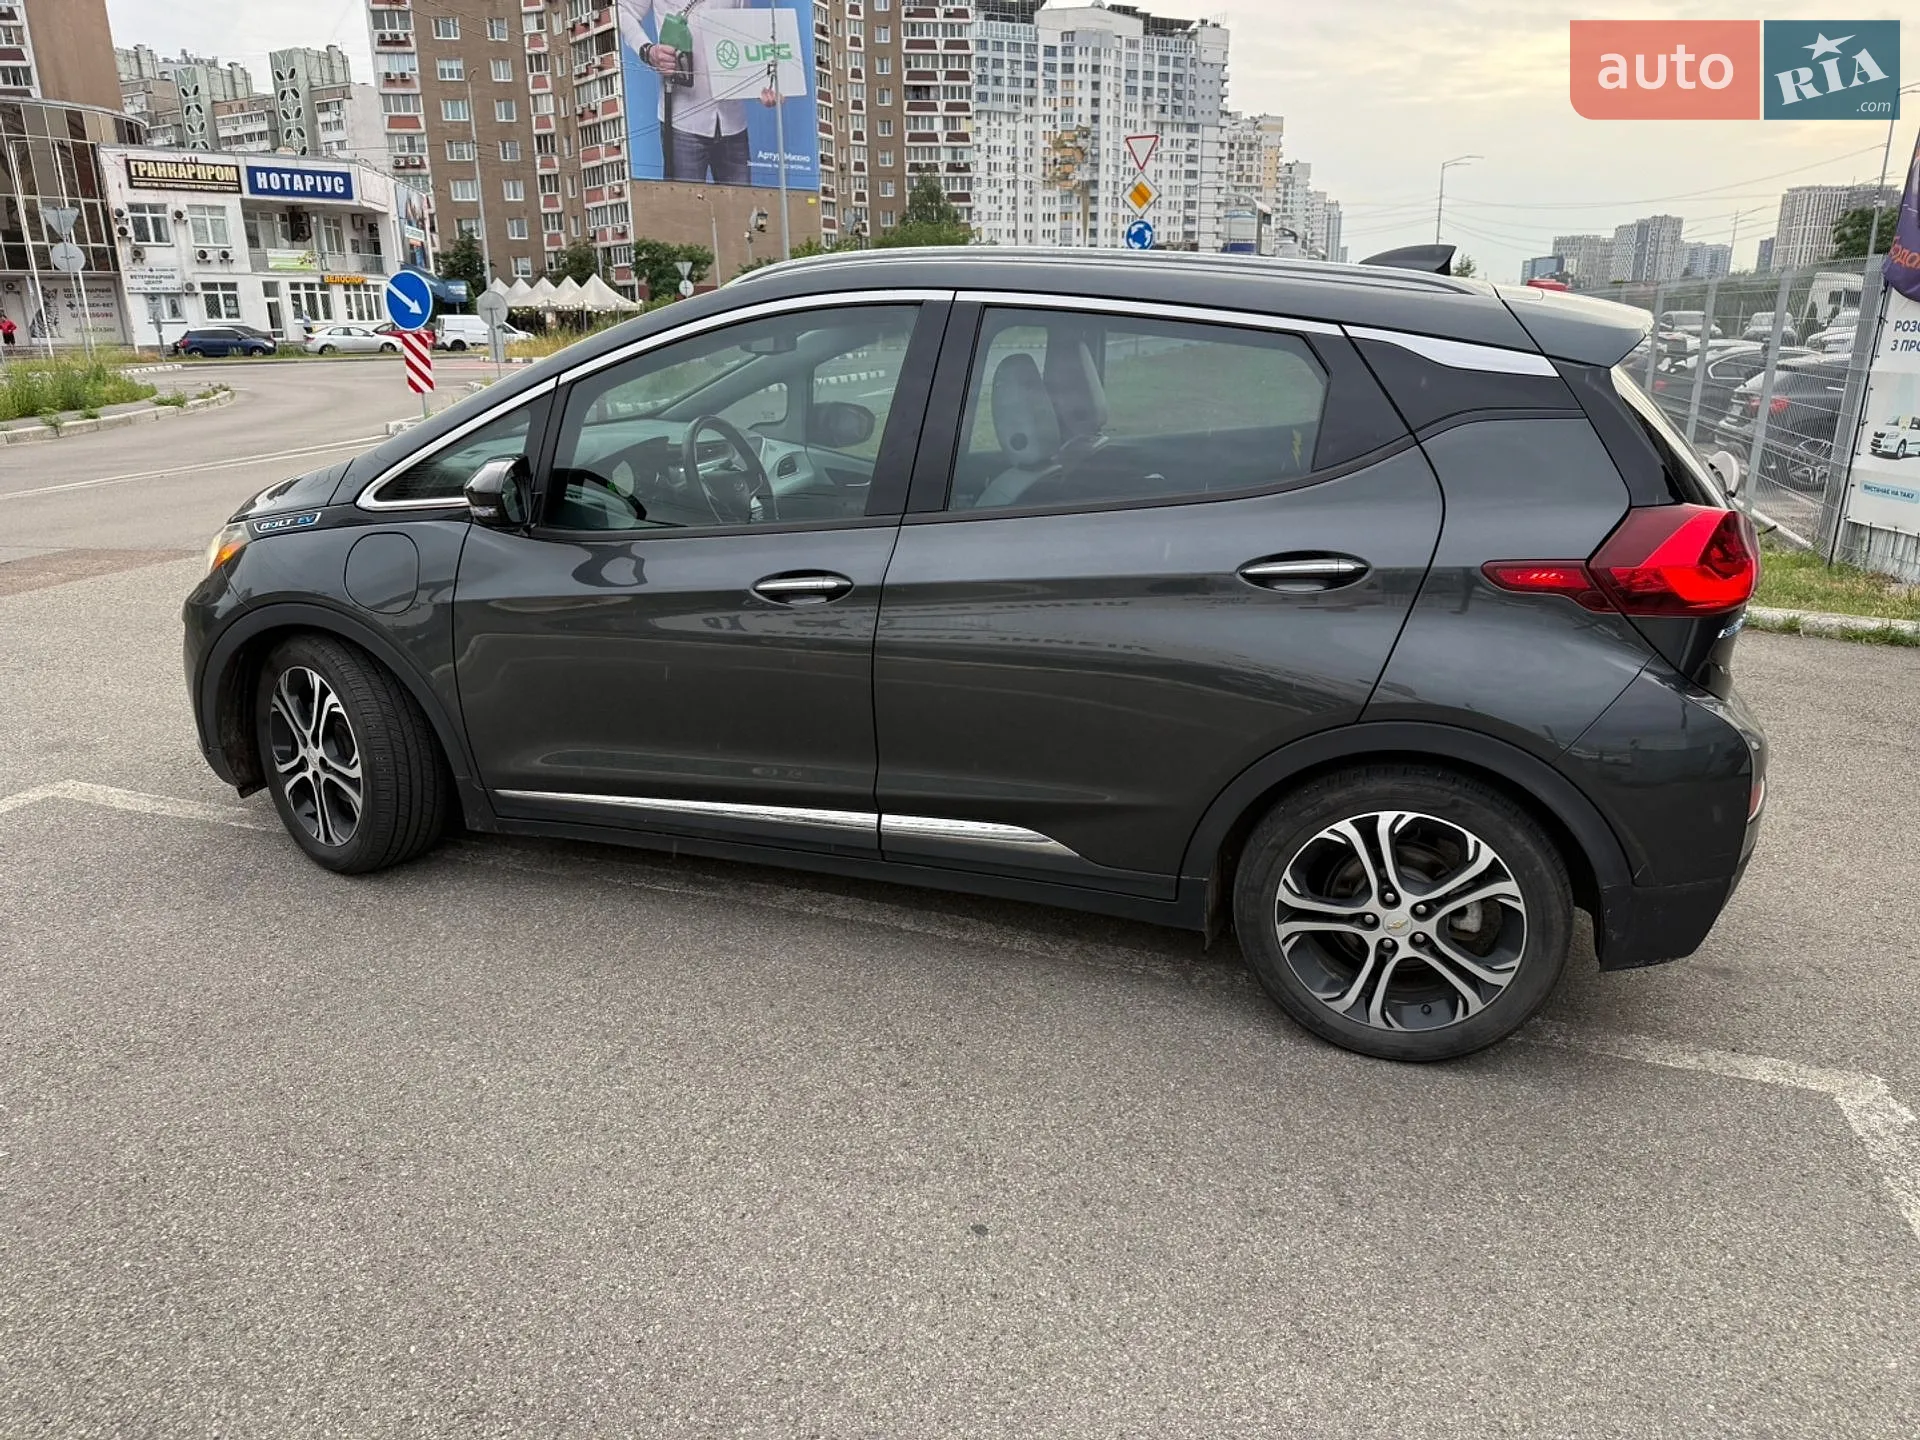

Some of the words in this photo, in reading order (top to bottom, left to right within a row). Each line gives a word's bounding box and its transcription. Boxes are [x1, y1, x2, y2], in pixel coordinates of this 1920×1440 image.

[744, 43, 792, 62] UPG
[130, 161, 238, 181] ГРАНКАРПРОМ
[256, 172, 345, 194] НОТАРІУС
[260, 518, 294, 530] BOLT
[297, 514, 315, 524] EV
